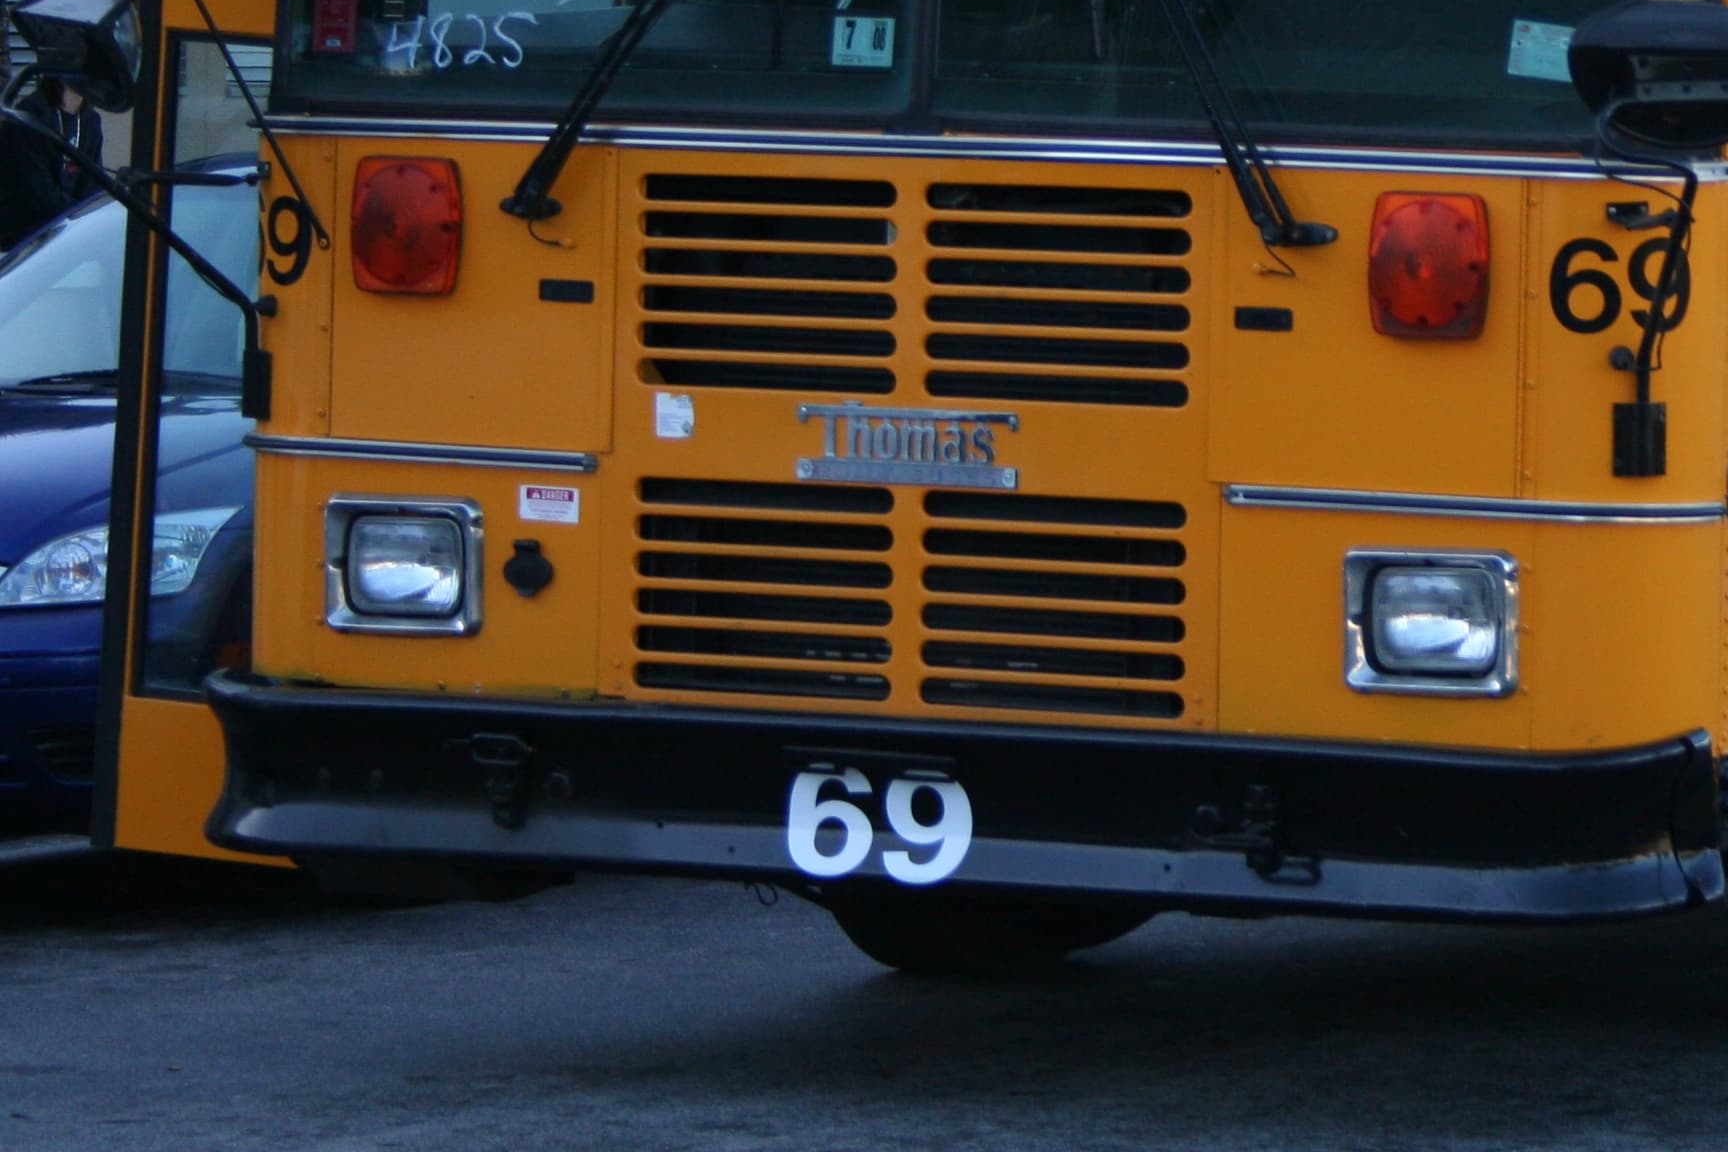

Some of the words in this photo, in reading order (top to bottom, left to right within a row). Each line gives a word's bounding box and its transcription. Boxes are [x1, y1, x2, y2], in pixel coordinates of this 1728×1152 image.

[387, 11, 540, 68] 4825
[845, 20, 857, 50] 7
[1549, 236, 1691, 335] 69
[797, 399, 1018, 465] Thomas
[787, 761, 974, 885] 69
